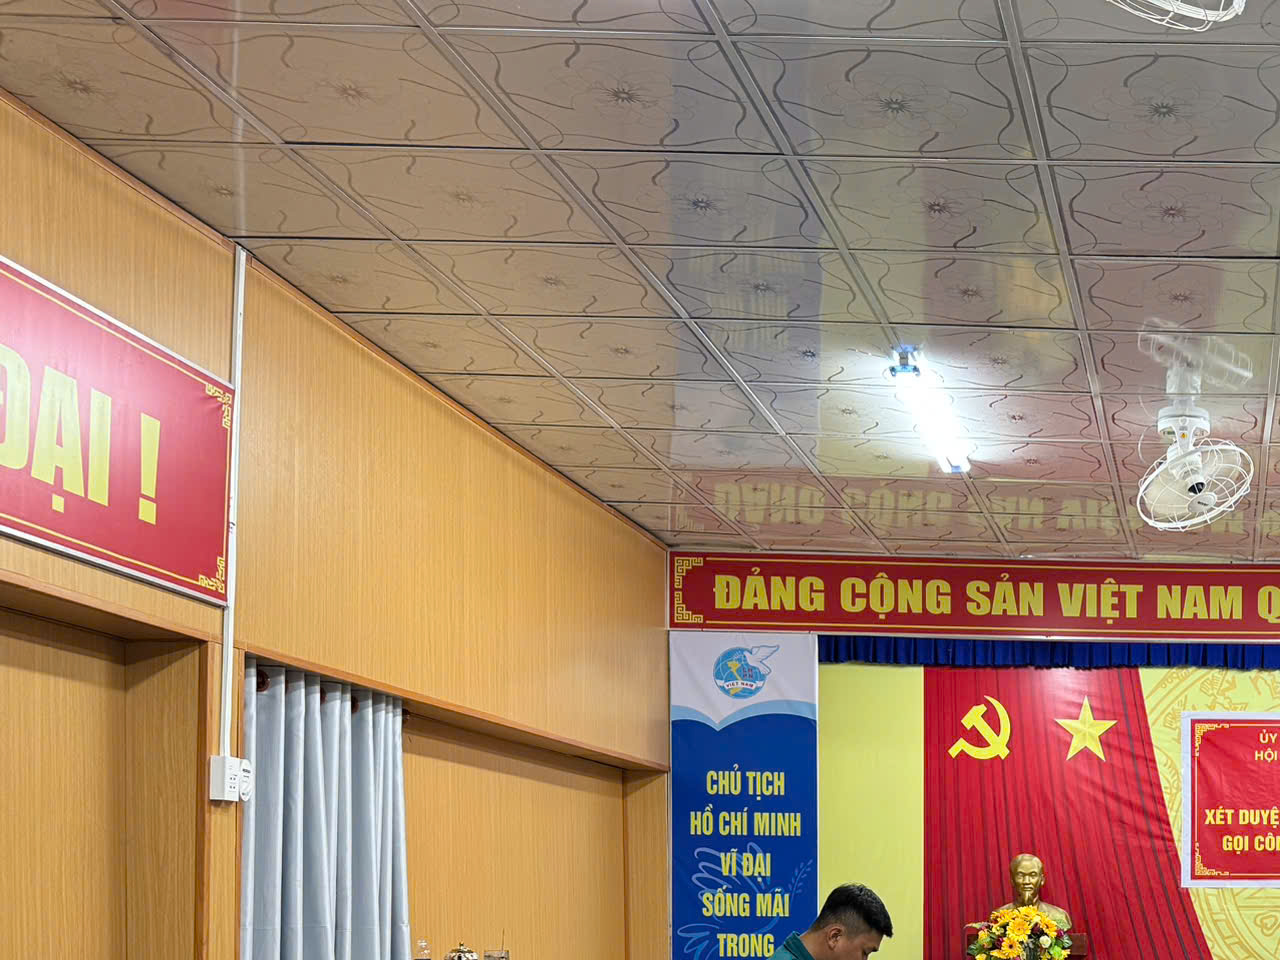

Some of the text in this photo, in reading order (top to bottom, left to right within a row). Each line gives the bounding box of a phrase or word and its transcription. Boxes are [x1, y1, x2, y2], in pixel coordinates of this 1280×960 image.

[0, 341, 161, 525] ĐẠI !
[713, 568, 825, 613] ĐẢNG
[840, 573, 951, 620] CỘNG
[966, 572, 1045, 617] SẢN
[1058, 577, 1144, 625] VIỆT
[1157, 585, 1243, 621] NAM
[1259, 729, 1279, 744] ỦY
[1254, 748, 1278, 764] HỘI
[706, 763, 785, 801] CHỦ TỊCH
[690, 803, 801, 837] HỒ CHÍ MINH
[1204, 806, 1233, 825] XÉT
[1222, 836, 1249, 854] GỌI
[720, 847, 771, 882] VĨ ĐẠI
[702, 885, 790, 917] SỐNG MÃI
[717, 933, 774, 958] TRONG
